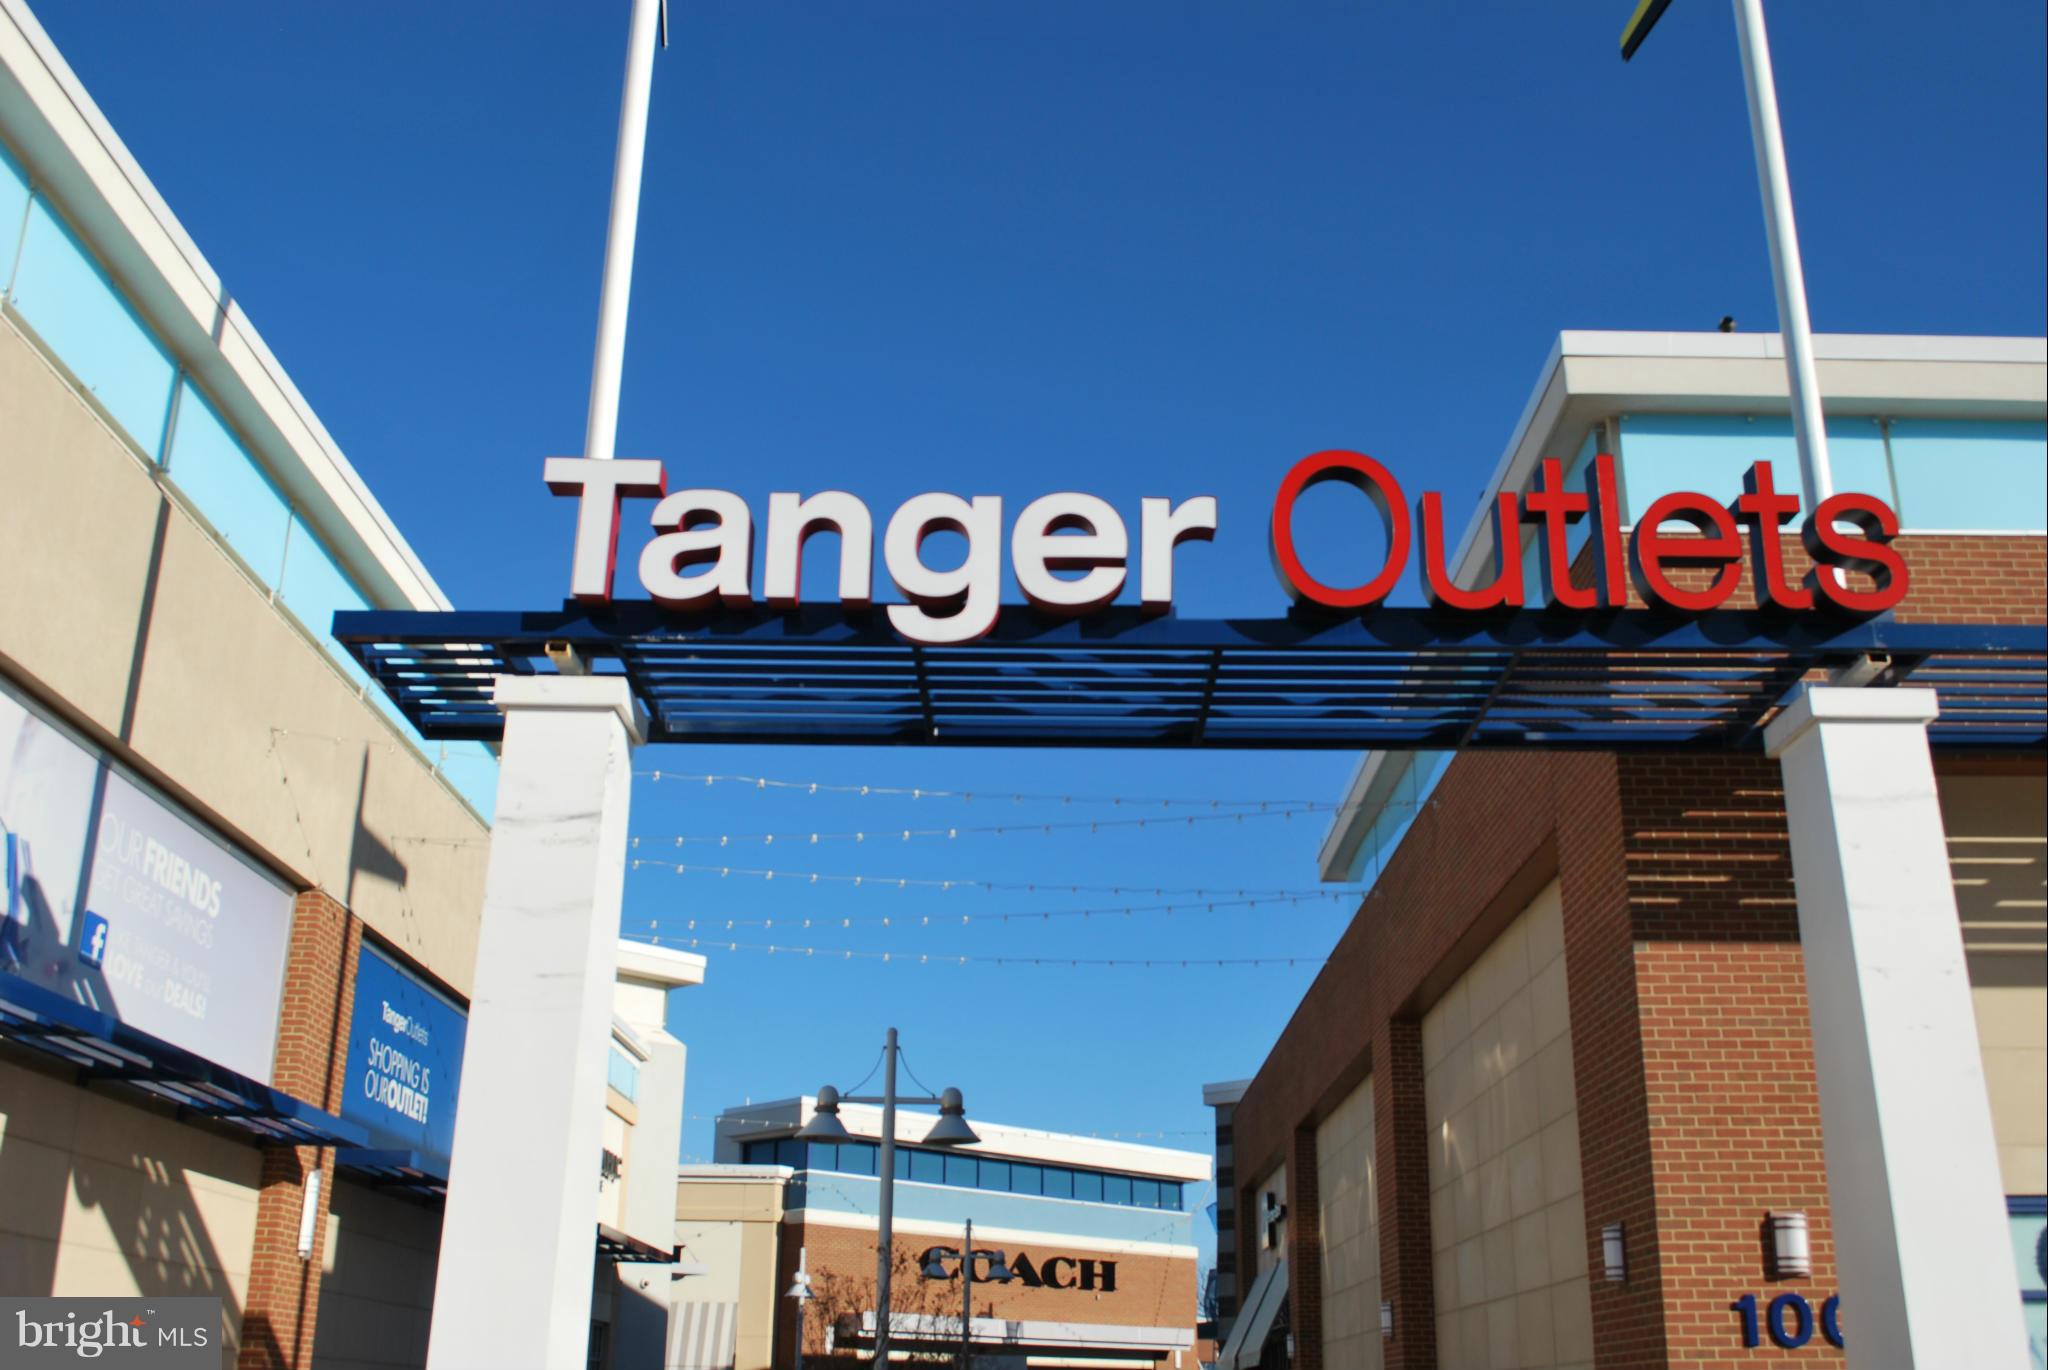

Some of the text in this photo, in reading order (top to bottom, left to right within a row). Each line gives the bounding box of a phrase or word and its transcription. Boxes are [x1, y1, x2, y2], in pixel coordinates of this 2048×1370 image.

[543, 449, 1909, 645] Tanger Outlets
[142, 836, 223, 919] FRIENDS
[368, 1037, 430, 1094] SHOPPING IS
[919, 1246, 1119, 1292] COACH
